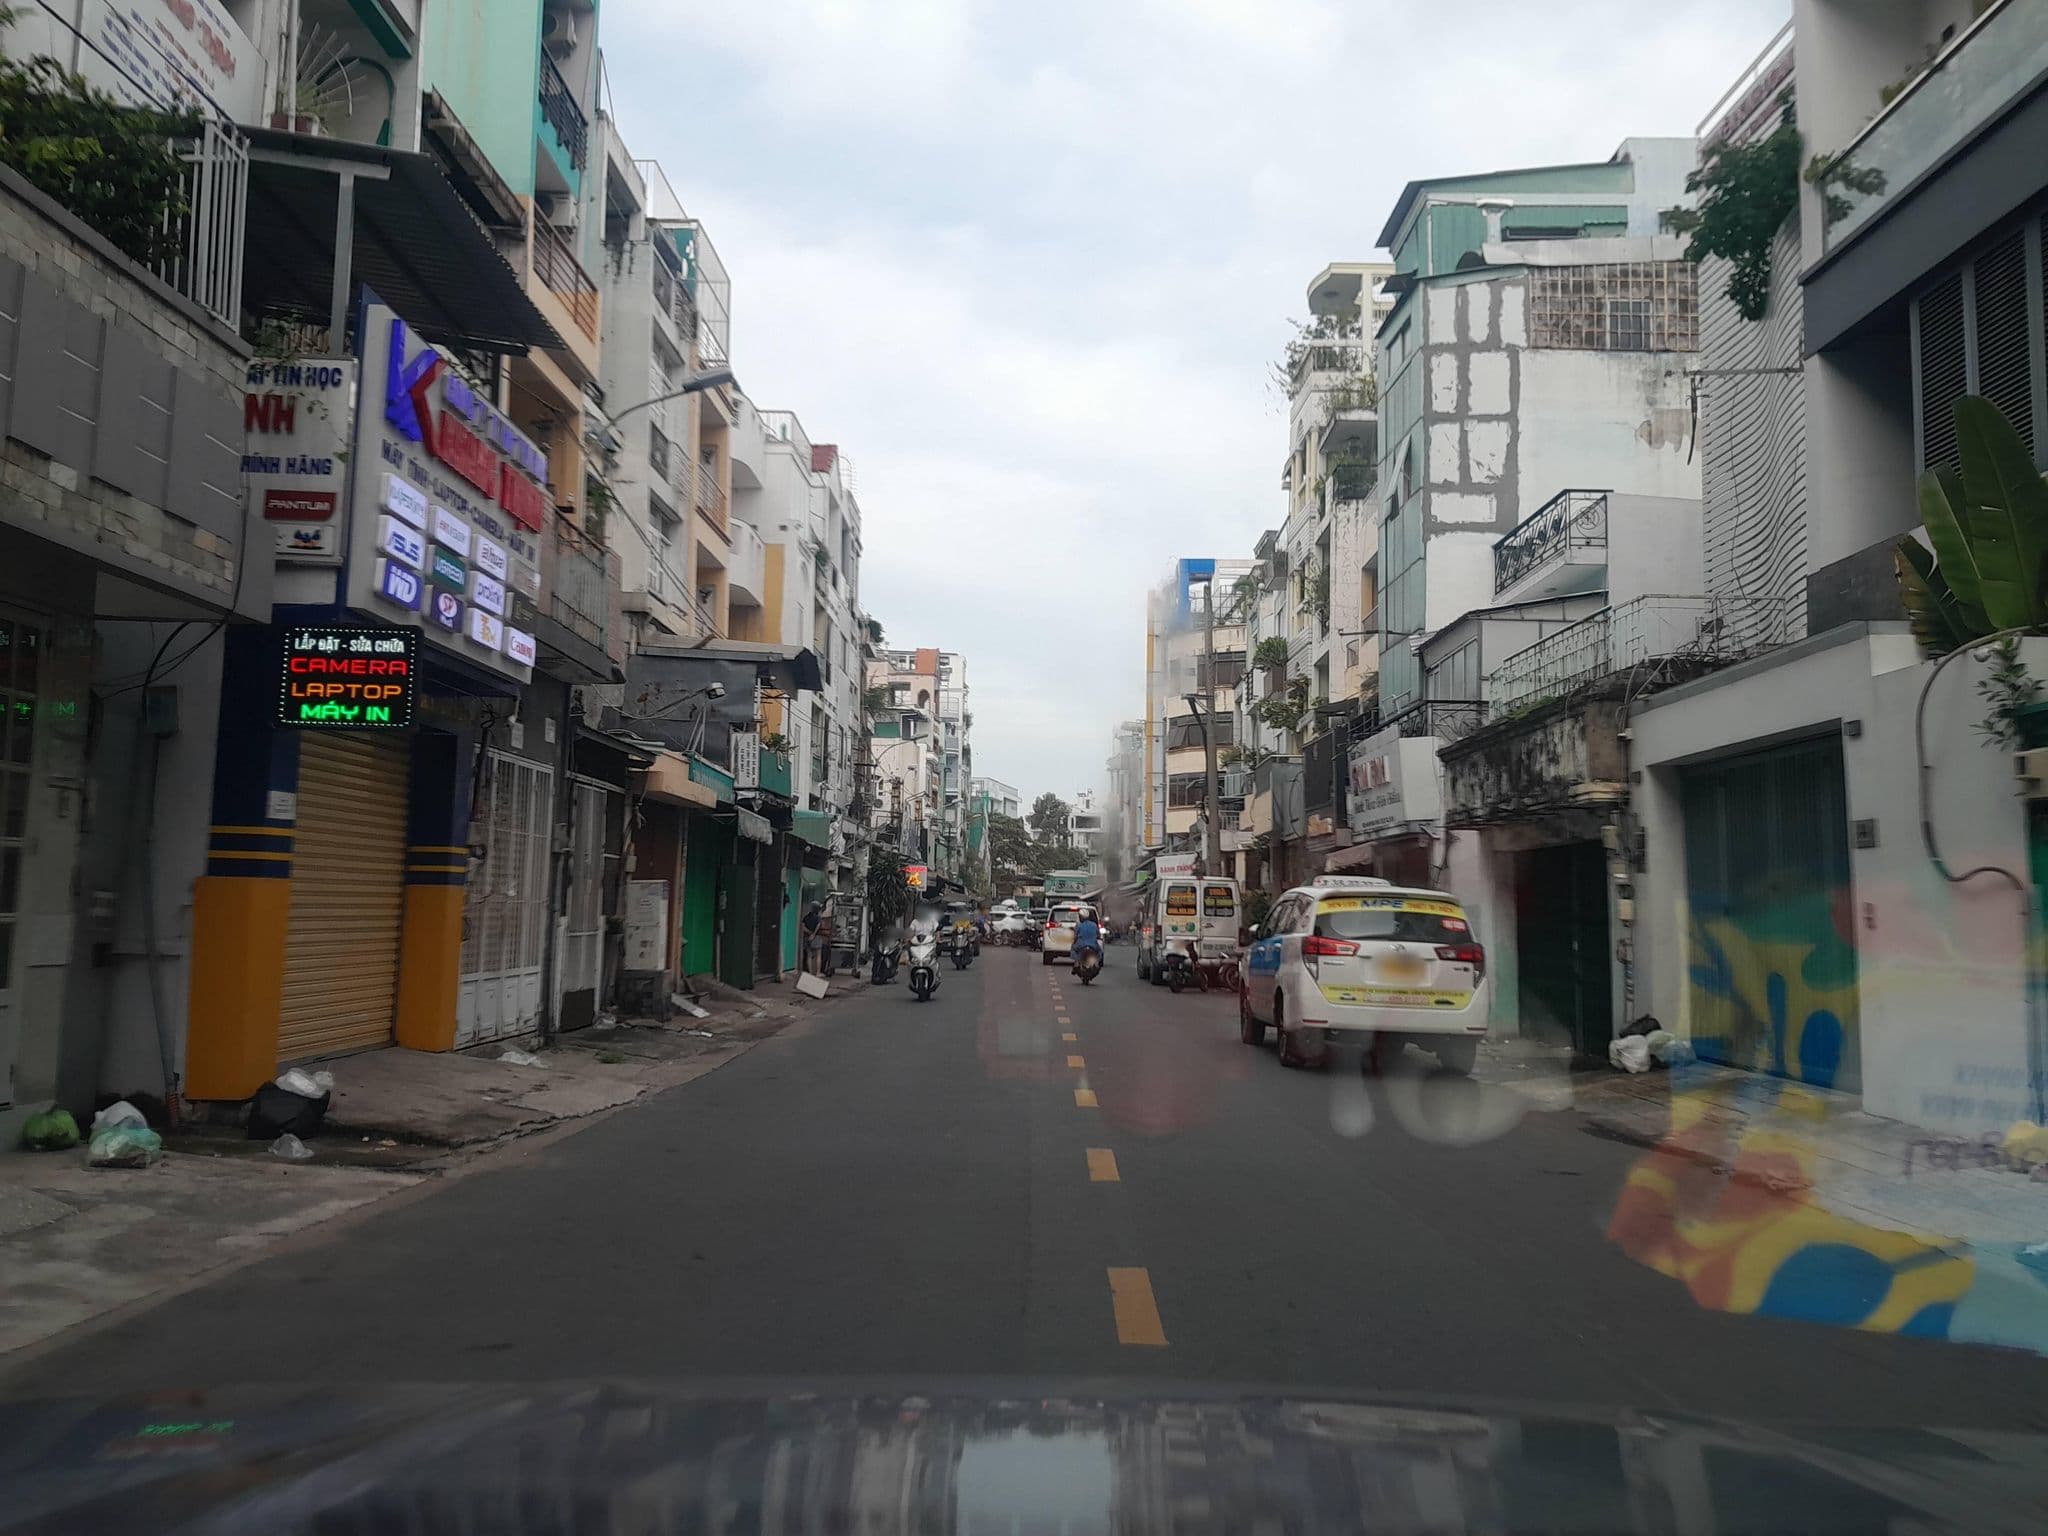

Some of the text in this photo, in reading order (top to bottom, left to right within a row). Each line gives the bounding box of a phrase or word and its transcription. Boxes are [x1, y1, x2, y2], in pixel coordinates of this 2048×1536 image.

[304, 366, 342, 390] HỌC
[266, 500, 331, 511] PANTUM
[294, 633, 316, 650] LẮP
[318, 636, 341, 653] ĐẶT
[350, 635, 372, 653] SỬA
[375, 638, 405, 653] CHỮA
[290, 657, 408, 676] CAMERA
[291, 682, 402, 699] LAPTOP
[300, 700, 390, 722] MÁY IN
